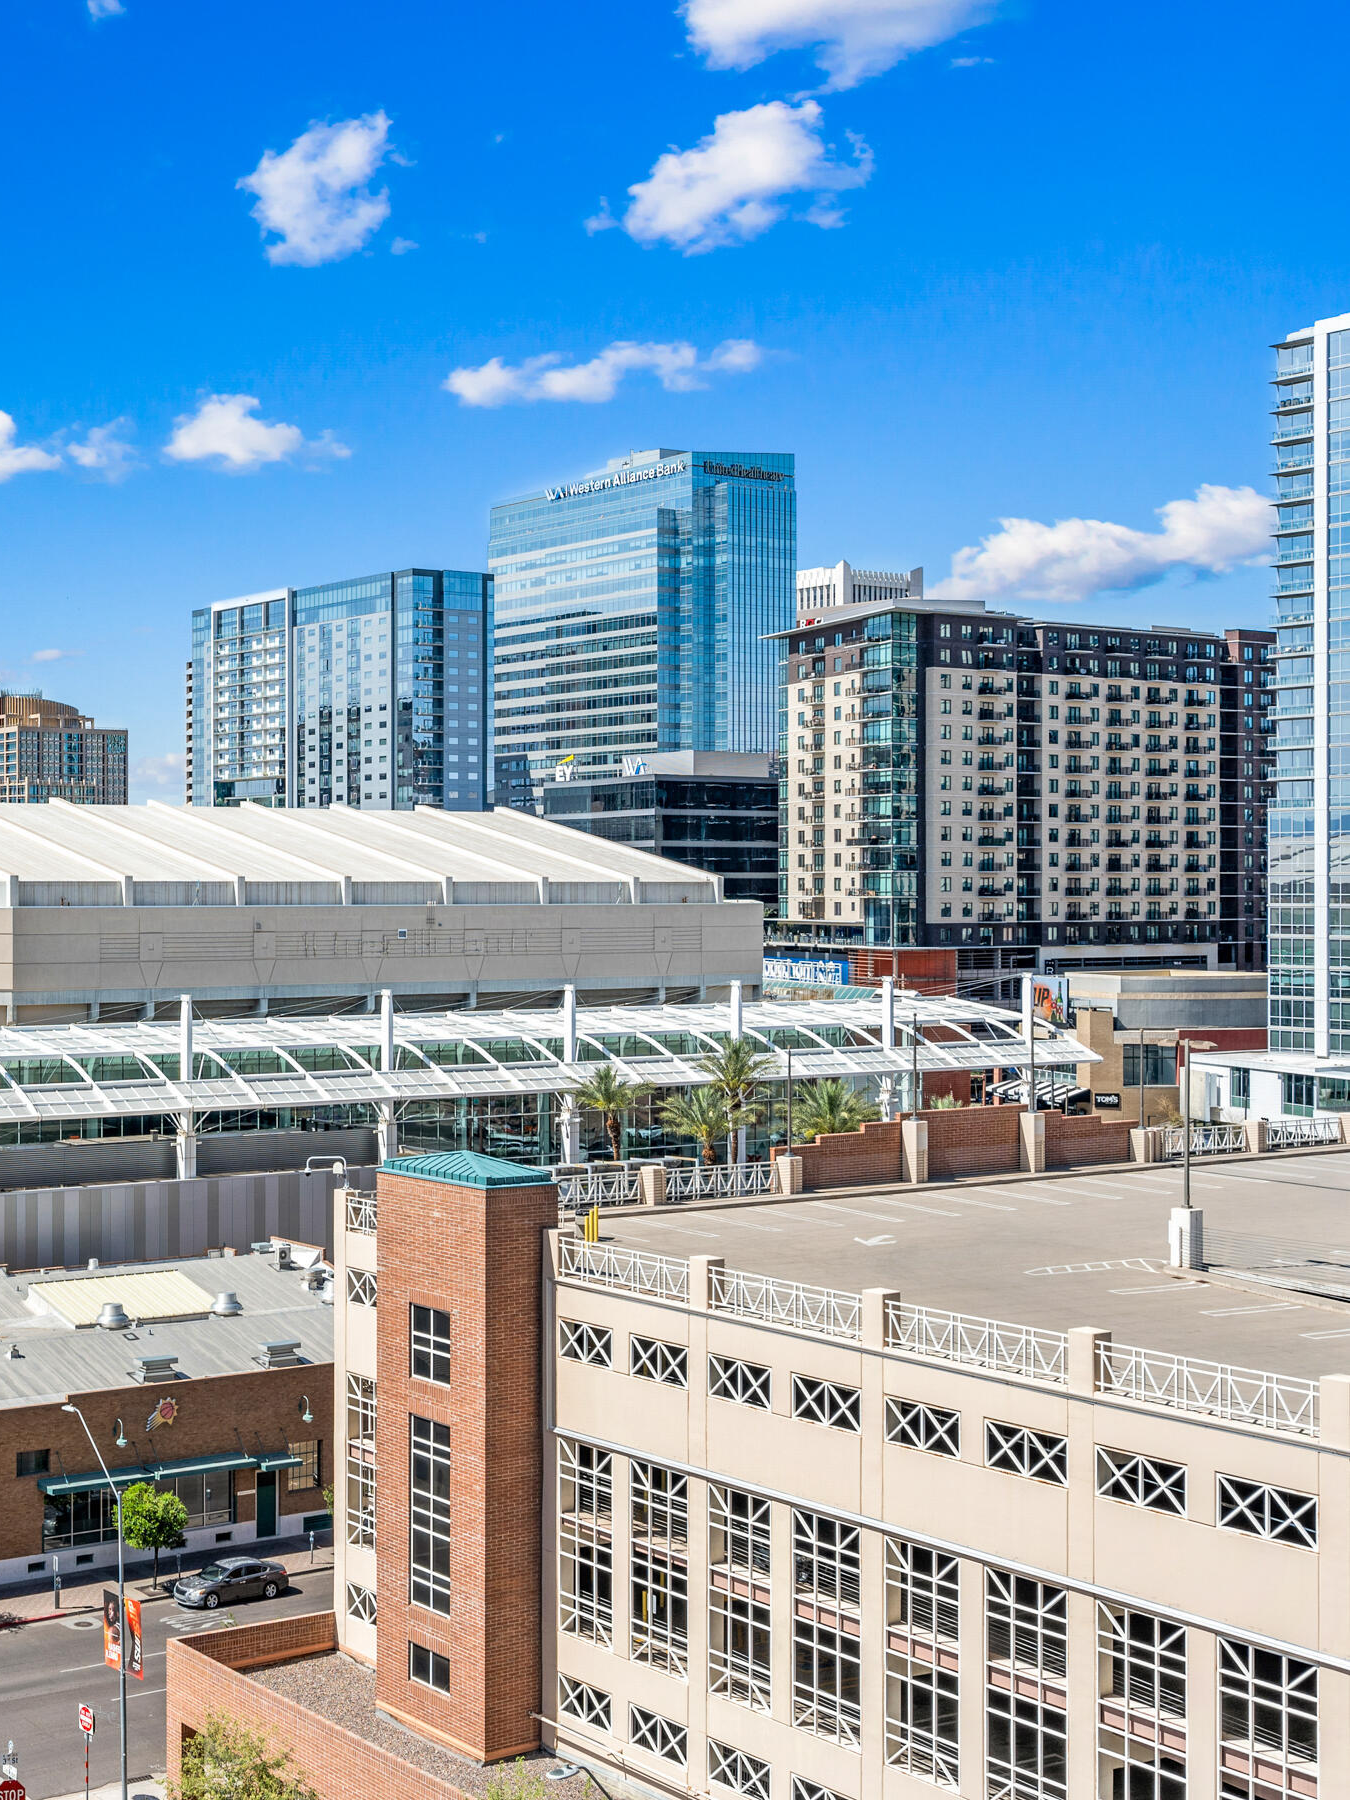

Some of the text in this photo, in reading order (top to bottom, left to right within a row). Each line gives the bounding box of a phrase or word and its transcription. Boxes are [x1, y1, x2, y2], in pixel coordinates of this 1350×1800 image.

[569, 478, 611, 495] Western
[613, 469, 654, 486] Alliance
[657, 460, 684, 476] Bank
[555, 765, 573, 782] EY
